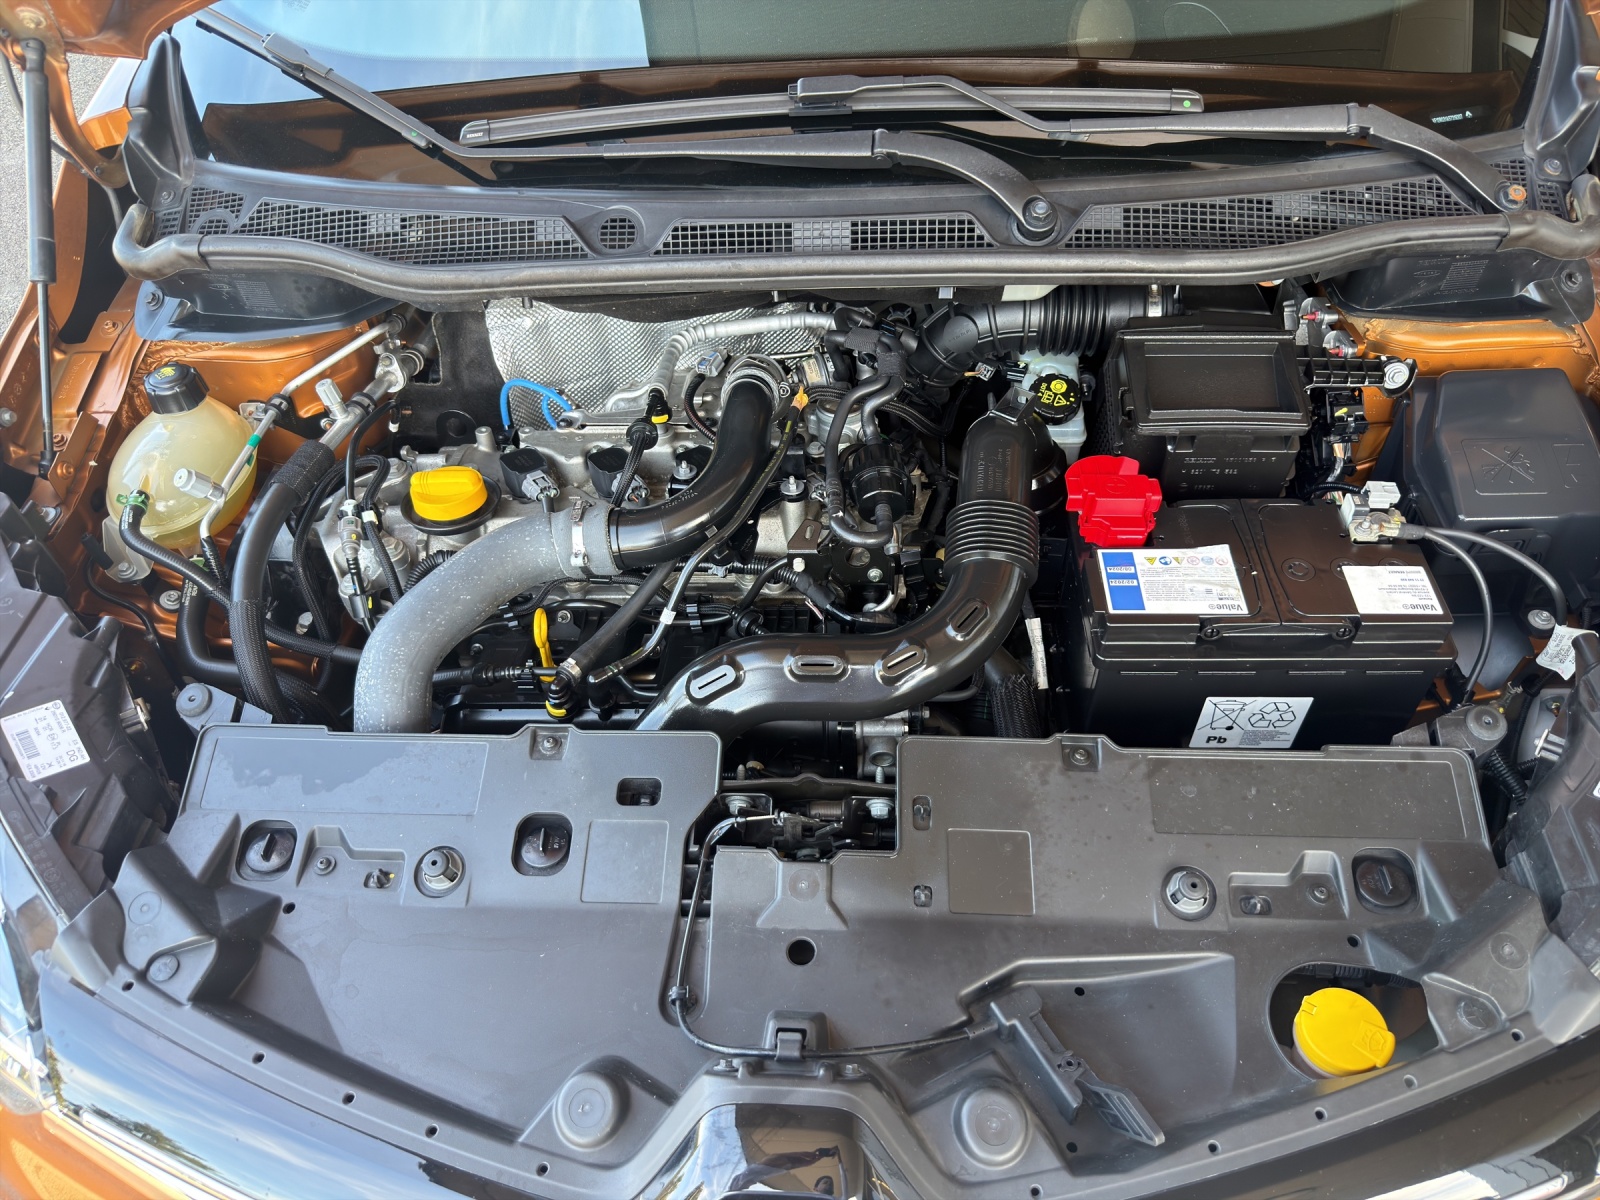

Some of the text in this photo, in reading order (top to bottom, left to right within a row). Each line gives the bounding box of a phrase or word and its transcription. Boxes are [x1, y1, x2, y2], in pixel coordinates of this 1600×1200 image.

[1040, 383, 1048, 392] DOT
[1216, 603, 1243, 611] Value
[1410, 603, 1438, 611] Value
[1205, 736, 1227, 744] Pb
[65, 749, 79, 762] DG
